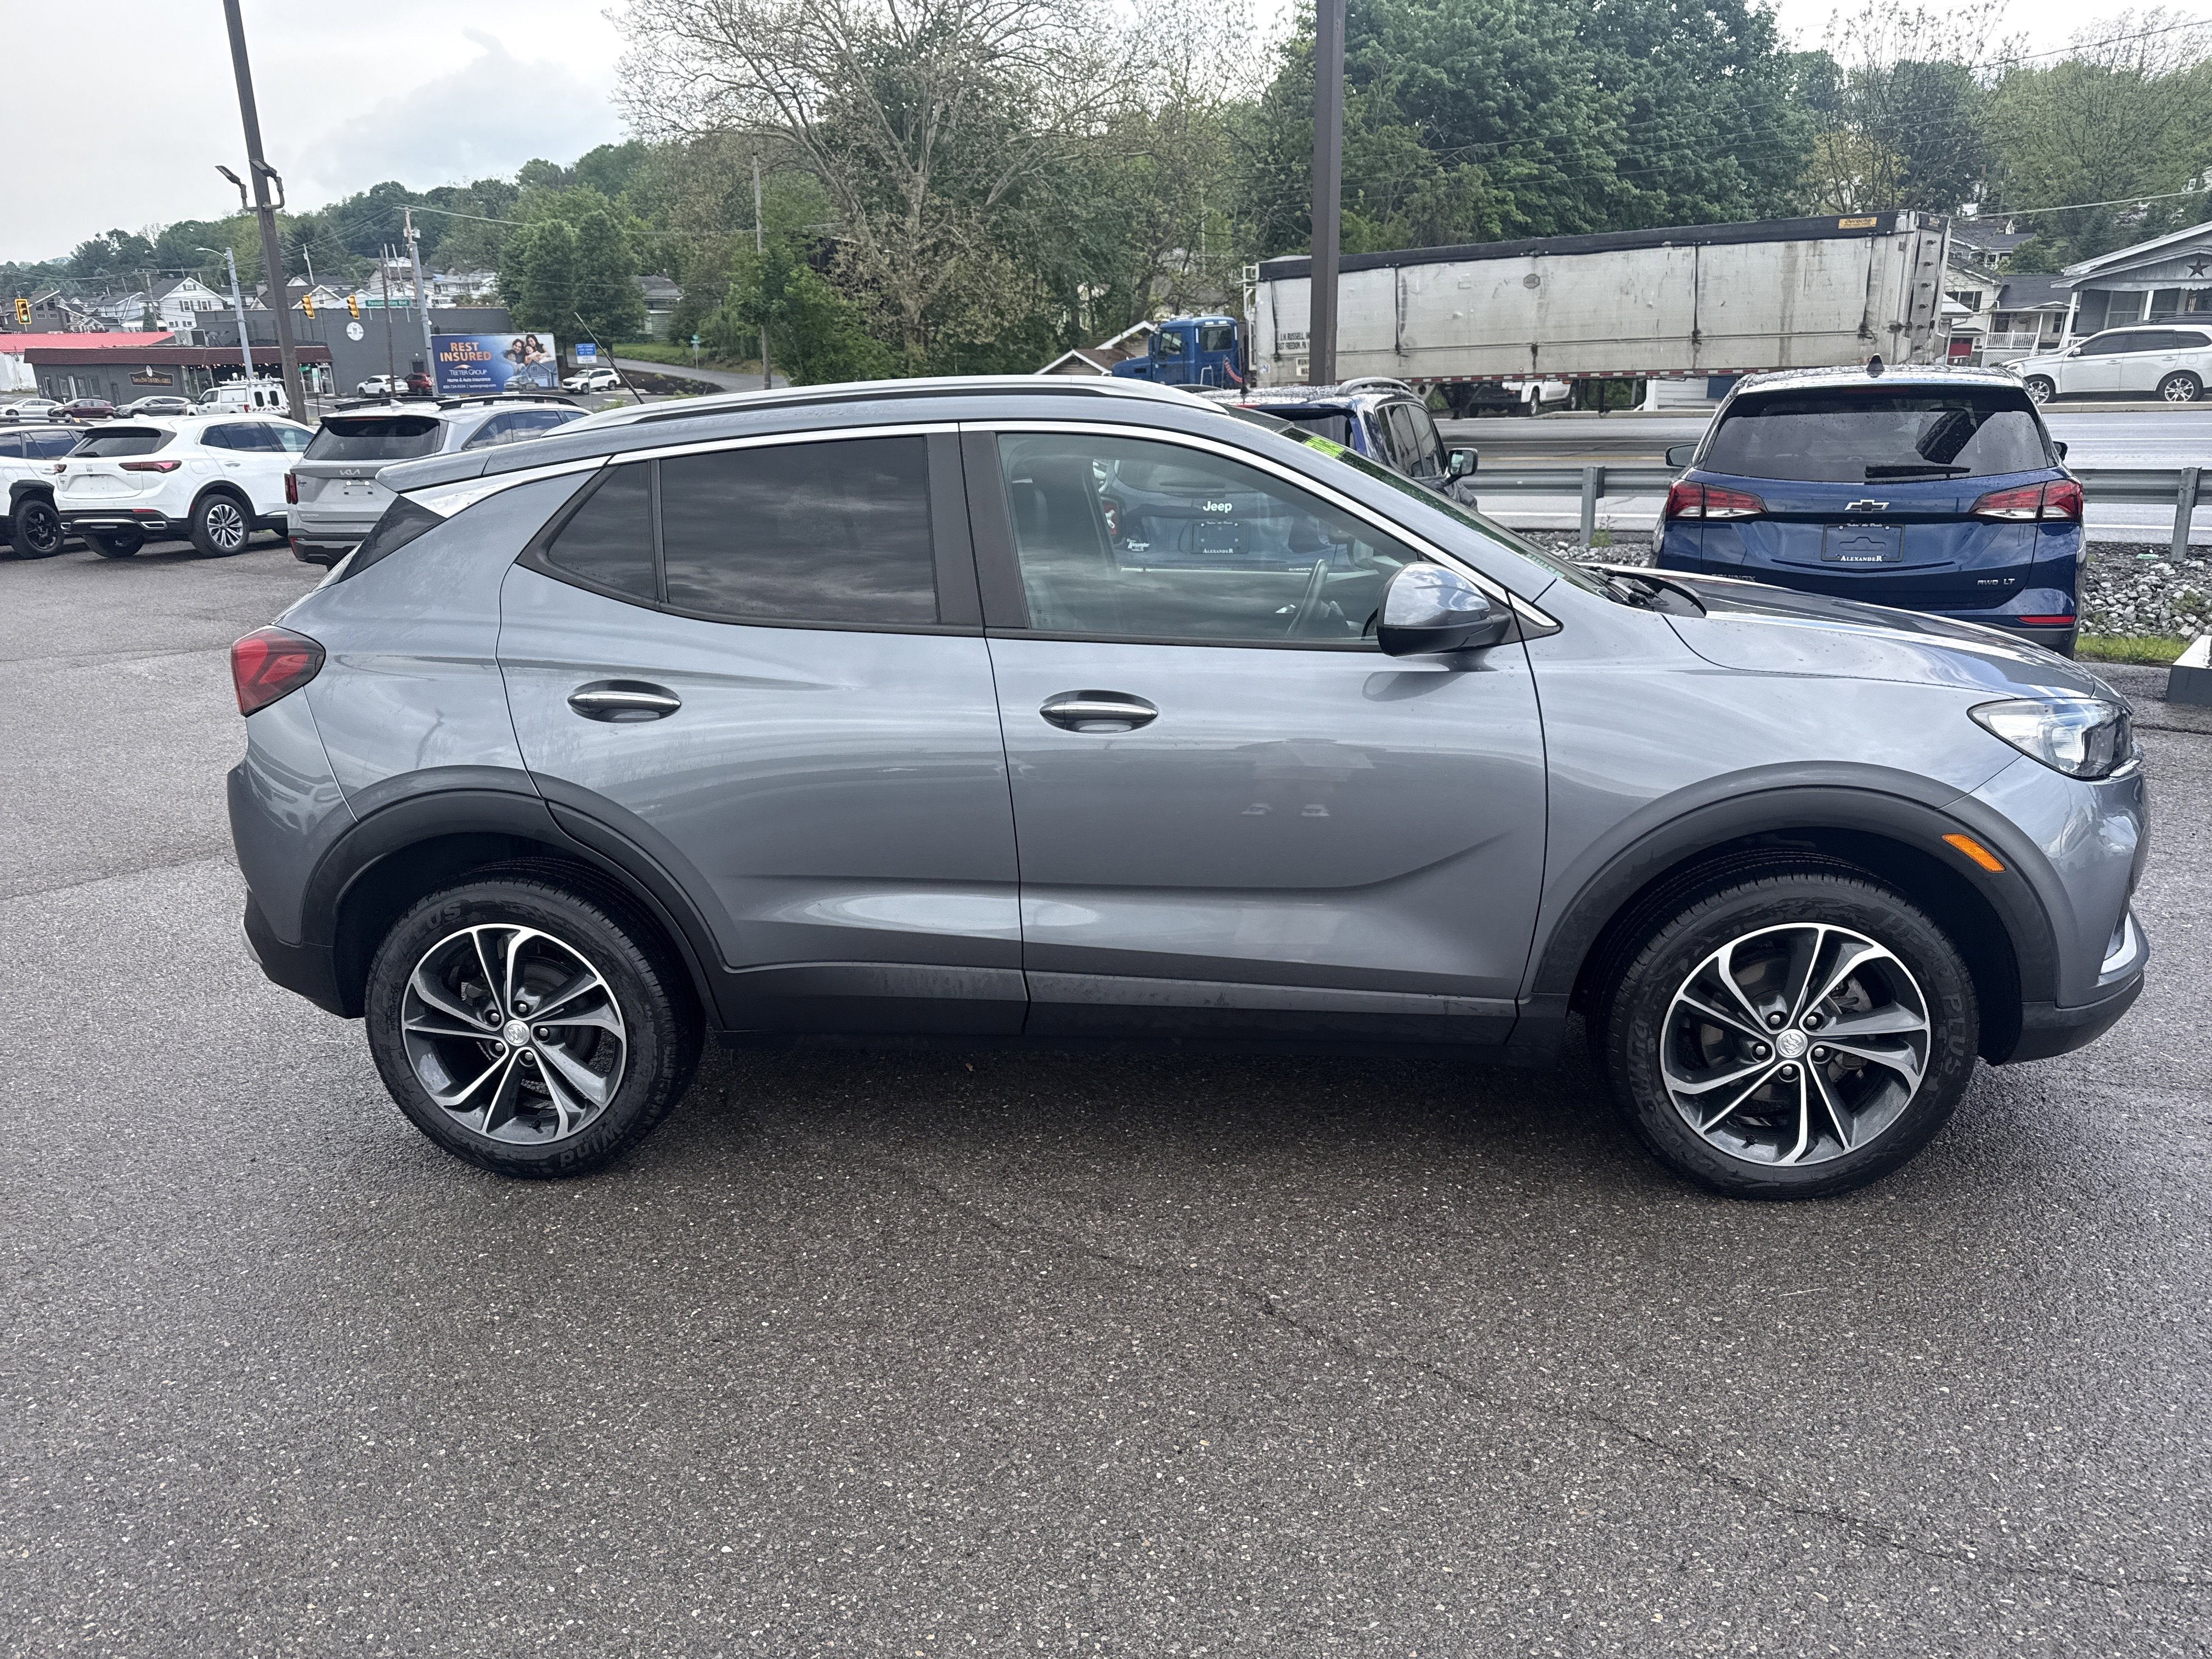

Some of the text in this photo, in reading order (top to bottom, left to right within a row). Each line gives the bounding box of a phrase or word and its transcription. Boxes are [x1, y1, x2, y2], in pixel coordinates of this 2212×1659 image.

[450, 342, 479, 352] REST
[439, 351, 492, 362] INSURED
[1203, 501, 1233, 514] Jeep
[1938, 991, 1968, 1077] PLUS
